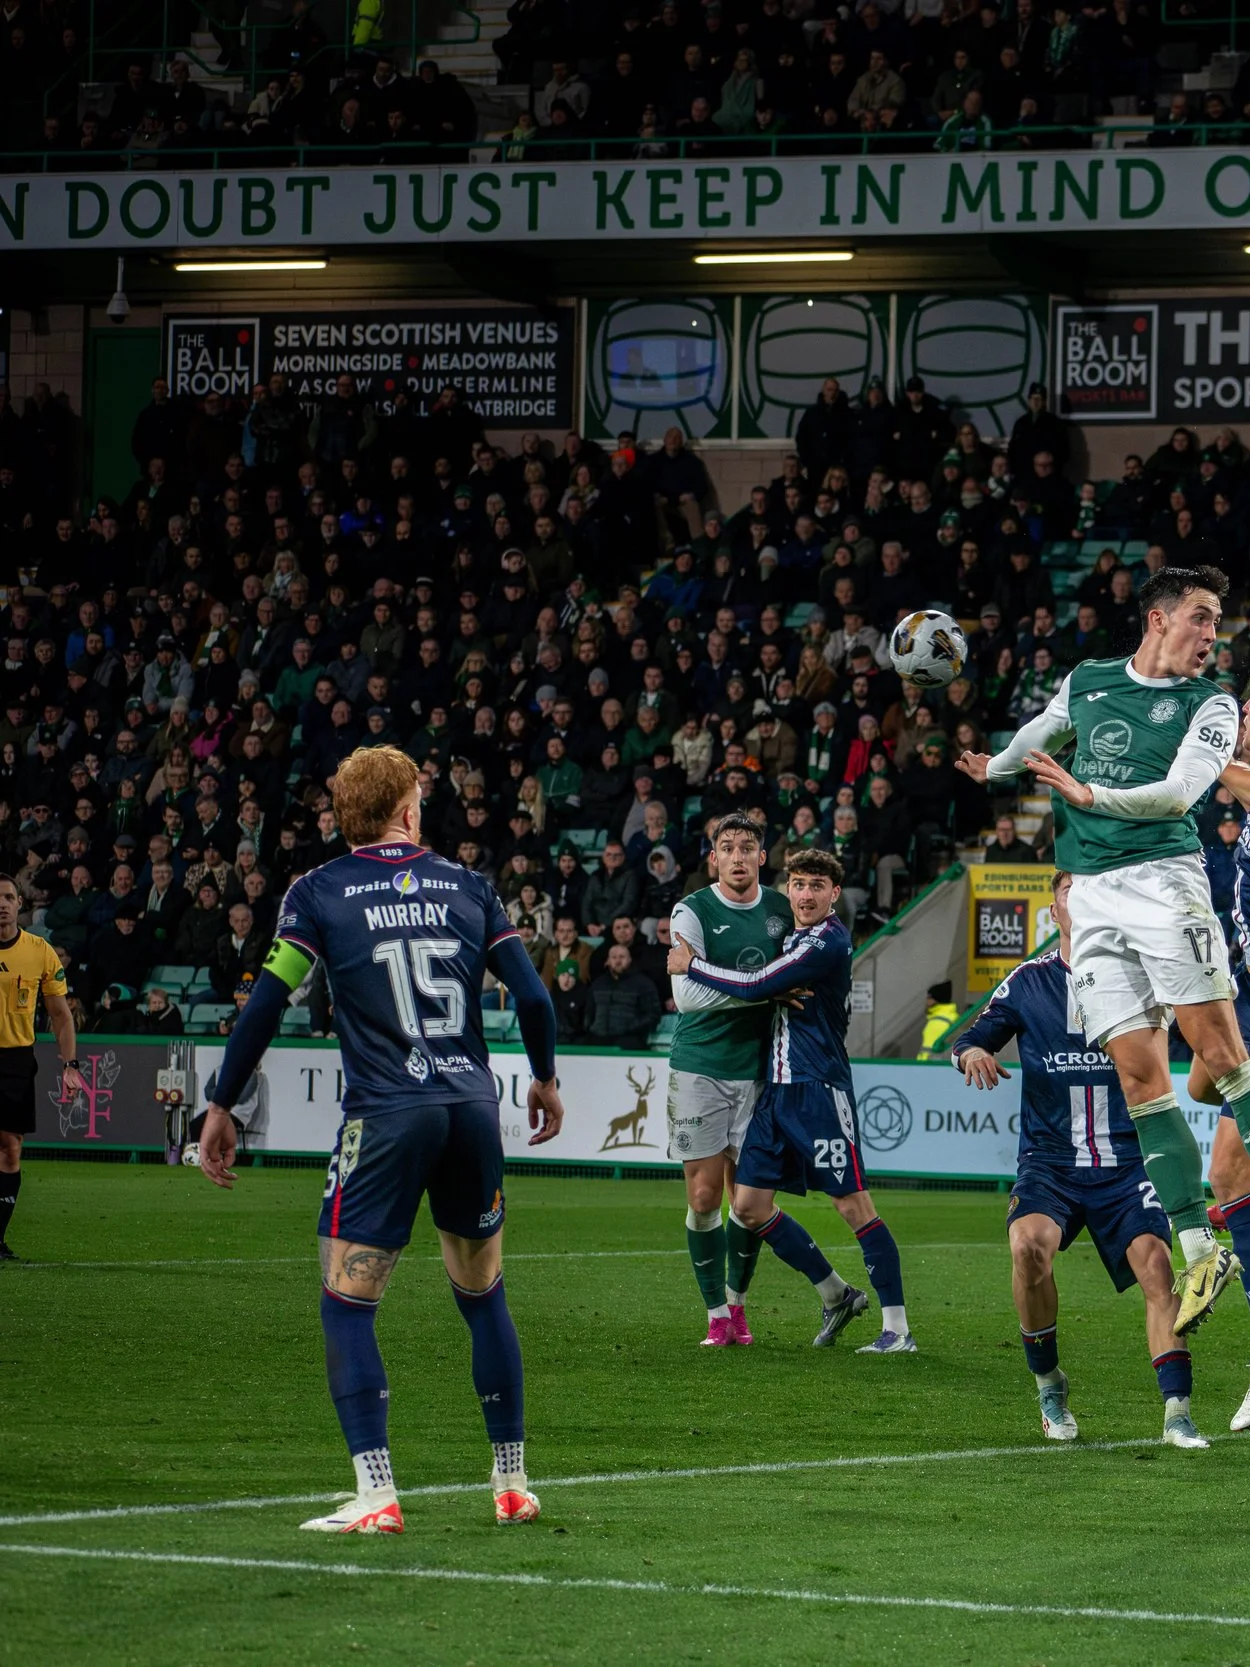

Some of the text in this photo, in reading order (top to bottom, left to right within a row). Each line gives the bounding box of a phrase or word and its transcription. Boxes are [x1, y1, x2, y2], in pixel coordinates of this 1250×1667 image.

[65, 176, 330, 239] DOUBT
[363, 172, 556, 234] JUST
[593, 166, 783, 230] KEEP
[820, 163, 905, 225] IN
[941, 158, 1165, 224] MIND
[273, 321, 559, 348] SEVEN SCOTTISH VENUES
[1068, 321, 1099, 336] THE
[178, 334, 205, 348] THE
[1067, 334, 1148, 361] BALL
[177, 348, 250, 372] BALL
[273, 351, 557, 373] MORNINGSIDE MEADOWBANK
[176, 372, 250, 396] ROOM
[1066, 360, 1148, 387] ROOM
[466, 399, 557, 417] ATBRIDGE
[1198, 726, 1231, 756] SBK
[1077, 756, 1136, 783] bevvy
[379, 848, 403, 857] 1893
[344, 878, 459, 898] Drain Blitz
[364, 902, 448, 931] MURRAY
[980, 913, 1023, 931] BALL
[980, 931, 1023, 946] ROOM
[1183, 928, 1212, 964] 17
[372, 939, 467, 1038] 15
[435, 1055, 471, 1066] ALPHA
[437, 1064, 474, 1073] PROJECTS
[1054, 1052, 1114, 1065] CROW
[925, 1109, 999, 1135] DIMA
[813, 1138, 847, 1169] 28
